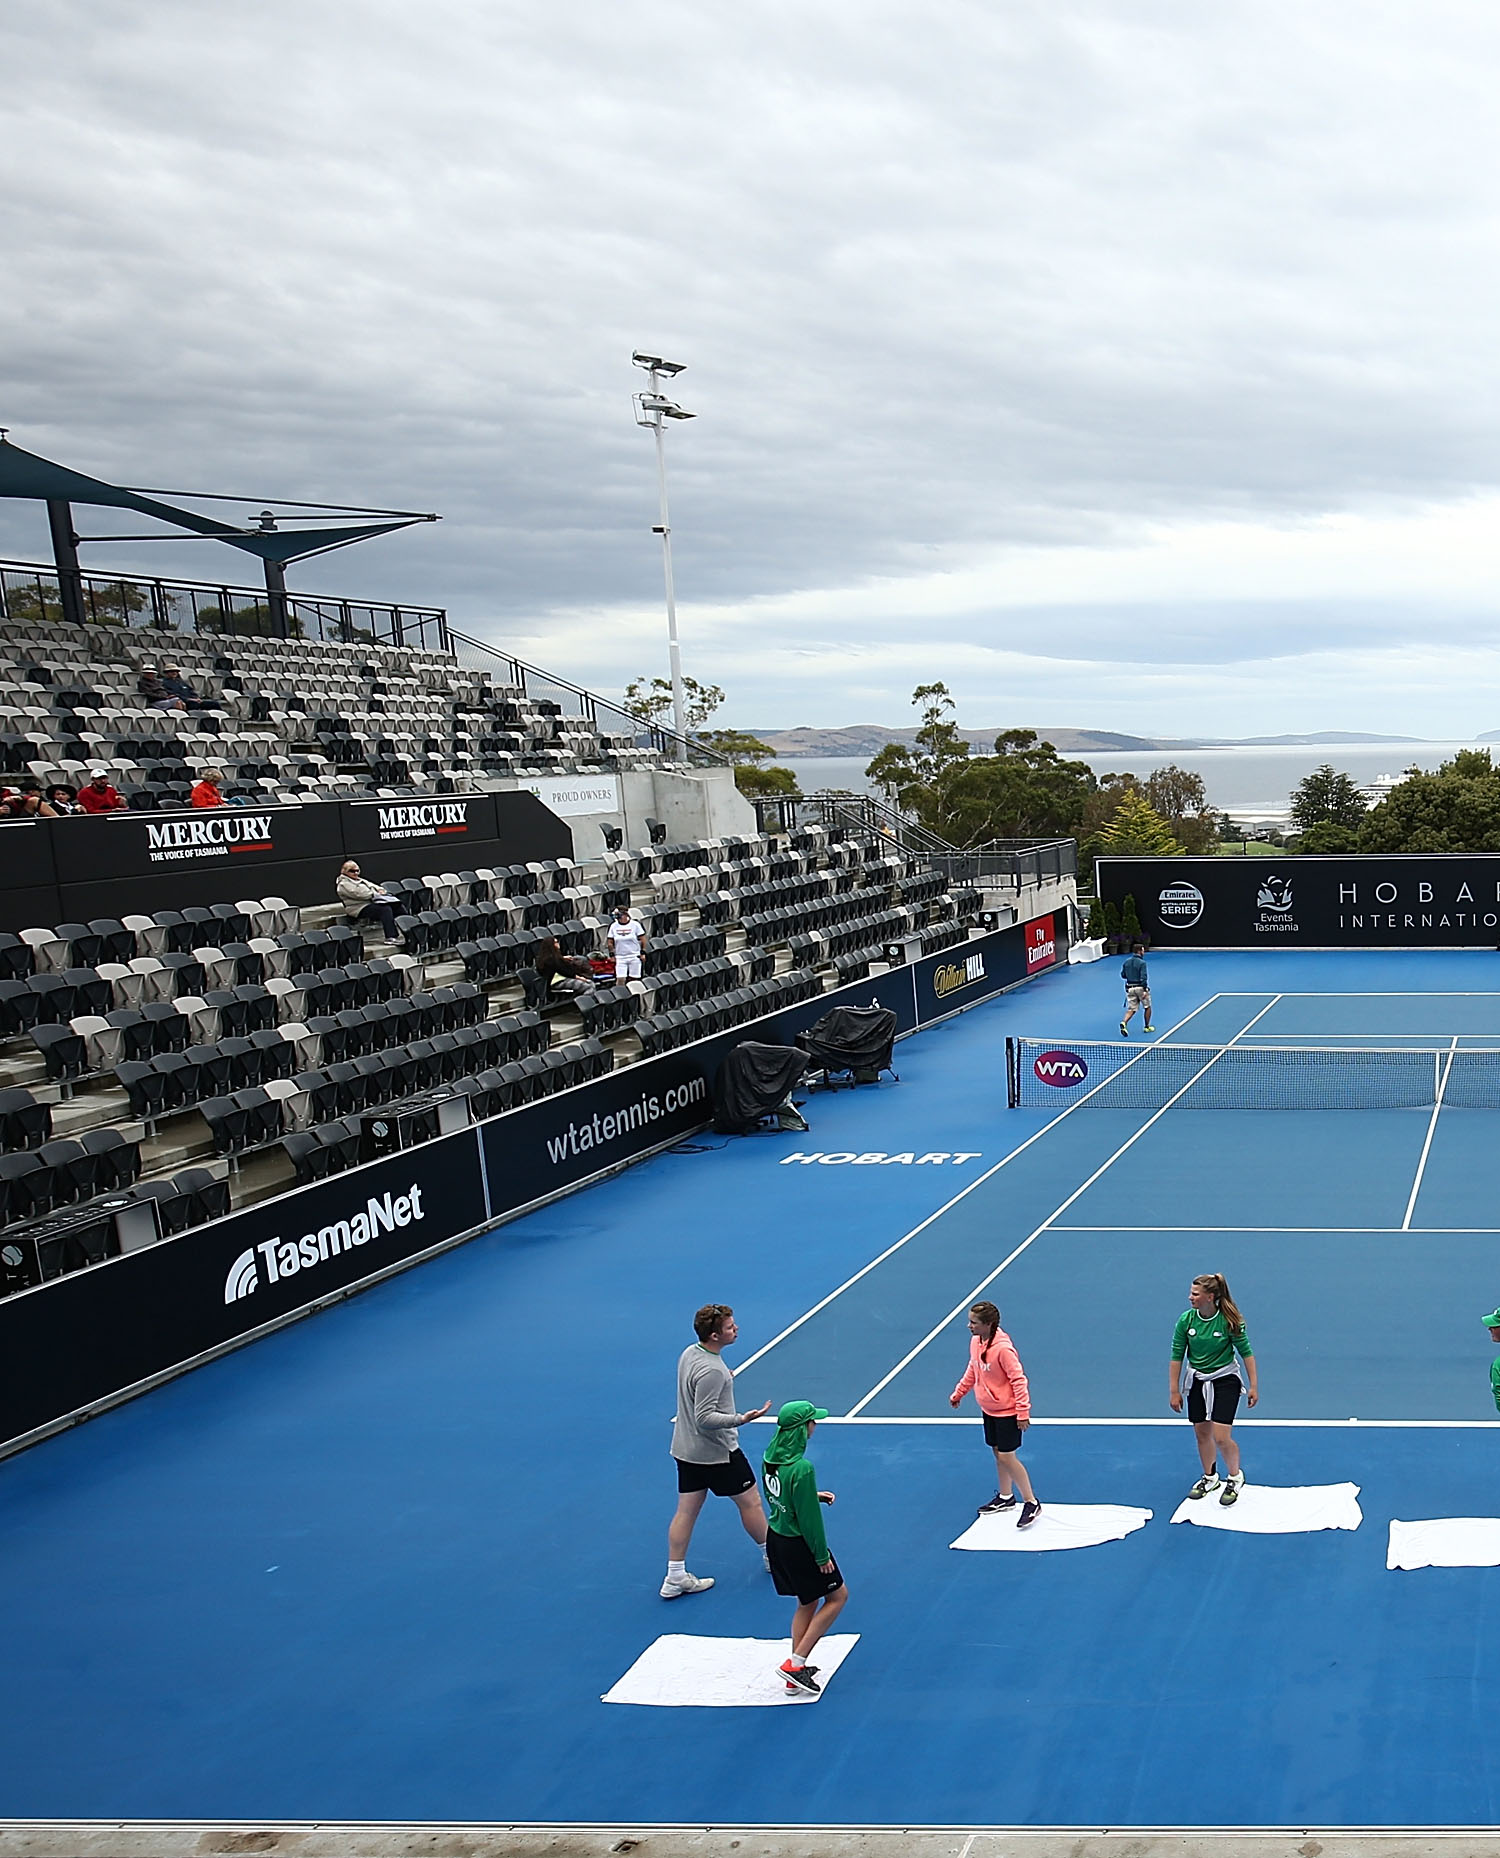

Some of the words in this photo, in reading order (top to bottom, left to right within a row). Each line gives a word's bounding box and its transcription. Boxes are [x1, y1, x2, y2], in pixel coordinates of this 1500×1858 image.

[552, 792, 578, 802] PROUD
[580, 790, 612, 800] OWNERS
[378, 803, 467, 829] MERCURY
[146, 816, 272, 848] MERCURY
[380, 832, 390, 840] THE
[391, 830, 404, 839] VOICE
[412, 828, 436, 836] TASMANIA
[150, 852, 164, 861] THE
[164, 850, 184, 860] VOICE
[185, 849, 194, 858] OF
[194, 846, 228, 857] TASMANIA
[1161, 906, 1198, 914] SERIES
[1261, 913, 1293, 922] Events
[1036, 928, 1045, 941] Fly
[1254, 923, 1299, 932] Tasmania
[1028, 940, 1055, 964] Emirates
[966, 952, 985, 982] HILL
[1037, 1061, 1084, 1078] WTA
[546, 1076, 706, 1164] wtatennis.com
[779, 1152, 983, 1165] HOBART
[257, 1182, 424, 1284] TasmaNet
